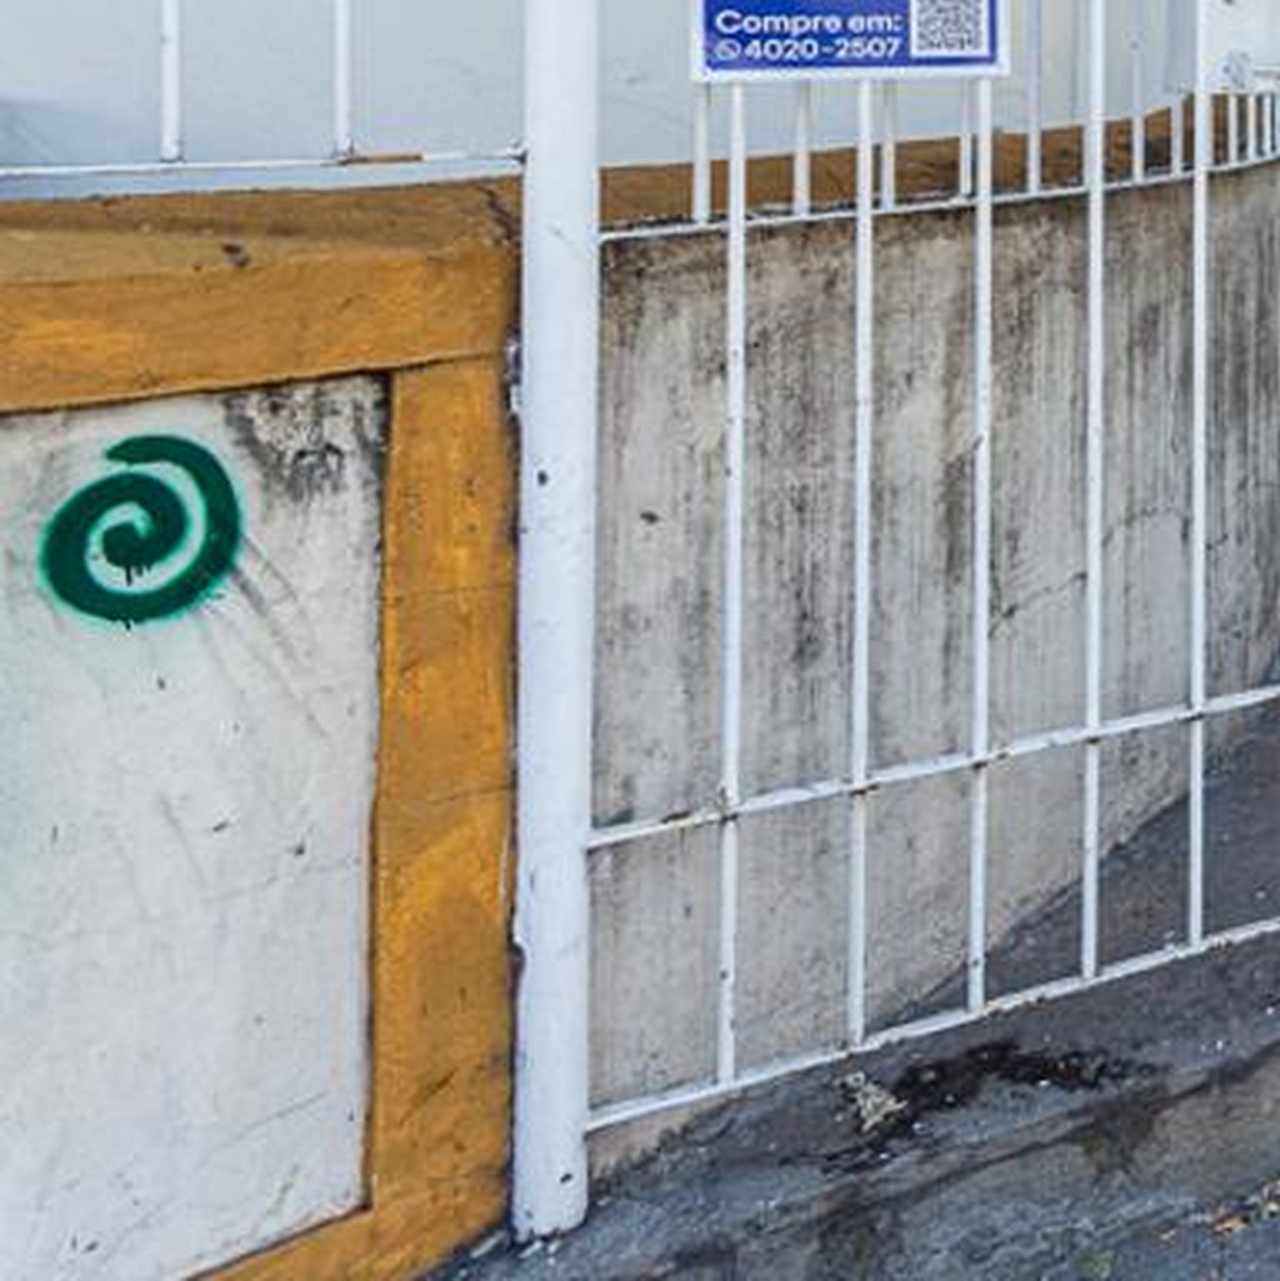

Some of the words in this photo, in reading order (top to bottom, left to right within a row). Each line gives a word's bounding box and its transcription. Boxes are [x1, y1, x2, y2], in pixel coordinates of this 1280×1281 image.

[715, 10, 842, 38] Compre
[847, 13, 903, 34] em:
[744, 37, 902, 59] 4020-2507
